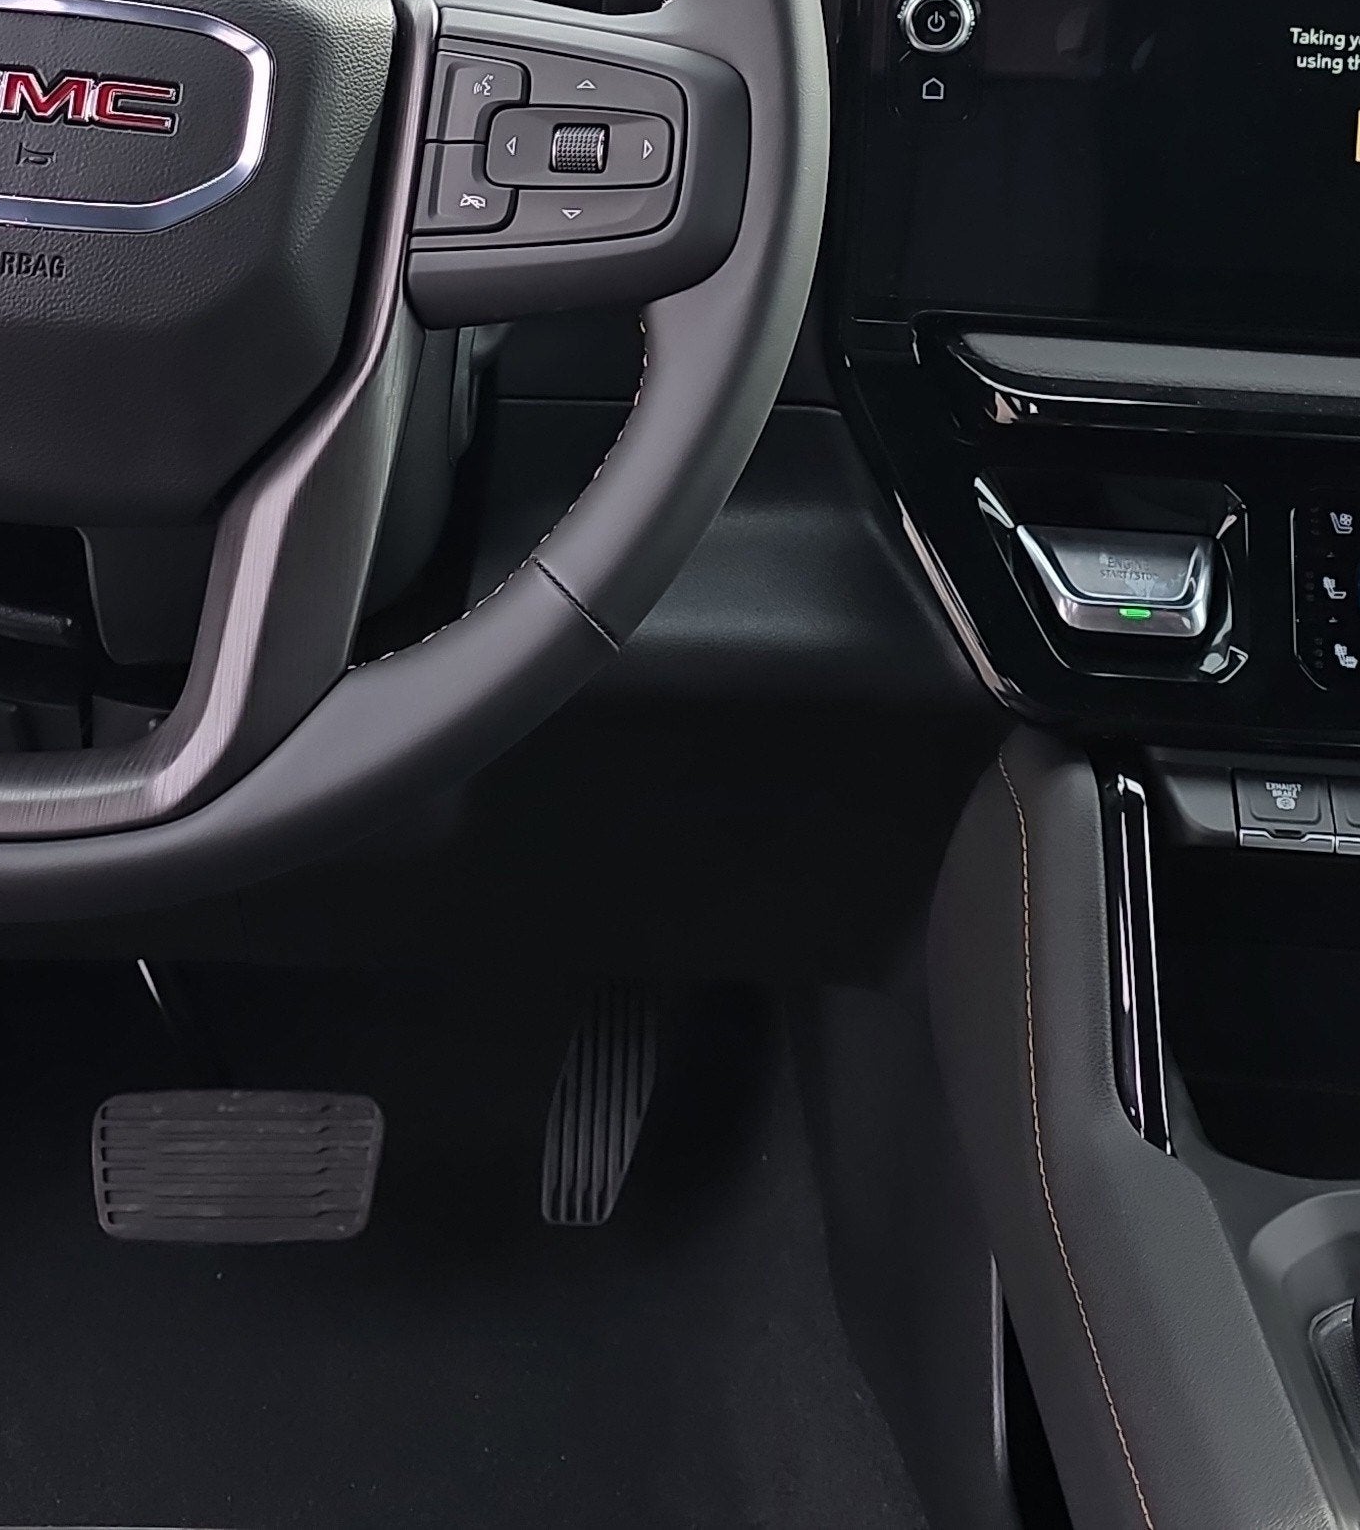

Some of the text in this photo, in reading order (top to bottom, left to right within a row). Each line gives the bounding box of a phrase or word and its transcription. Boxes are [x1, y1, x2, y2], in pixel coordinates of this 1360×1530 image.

[1289, 27, 1346, 51] Taking
[1296, 53, 1344, 74] using
[1265, 781, 1303, 793] EXHAUST
[1271, 788, 1299, 800] BRAKE
